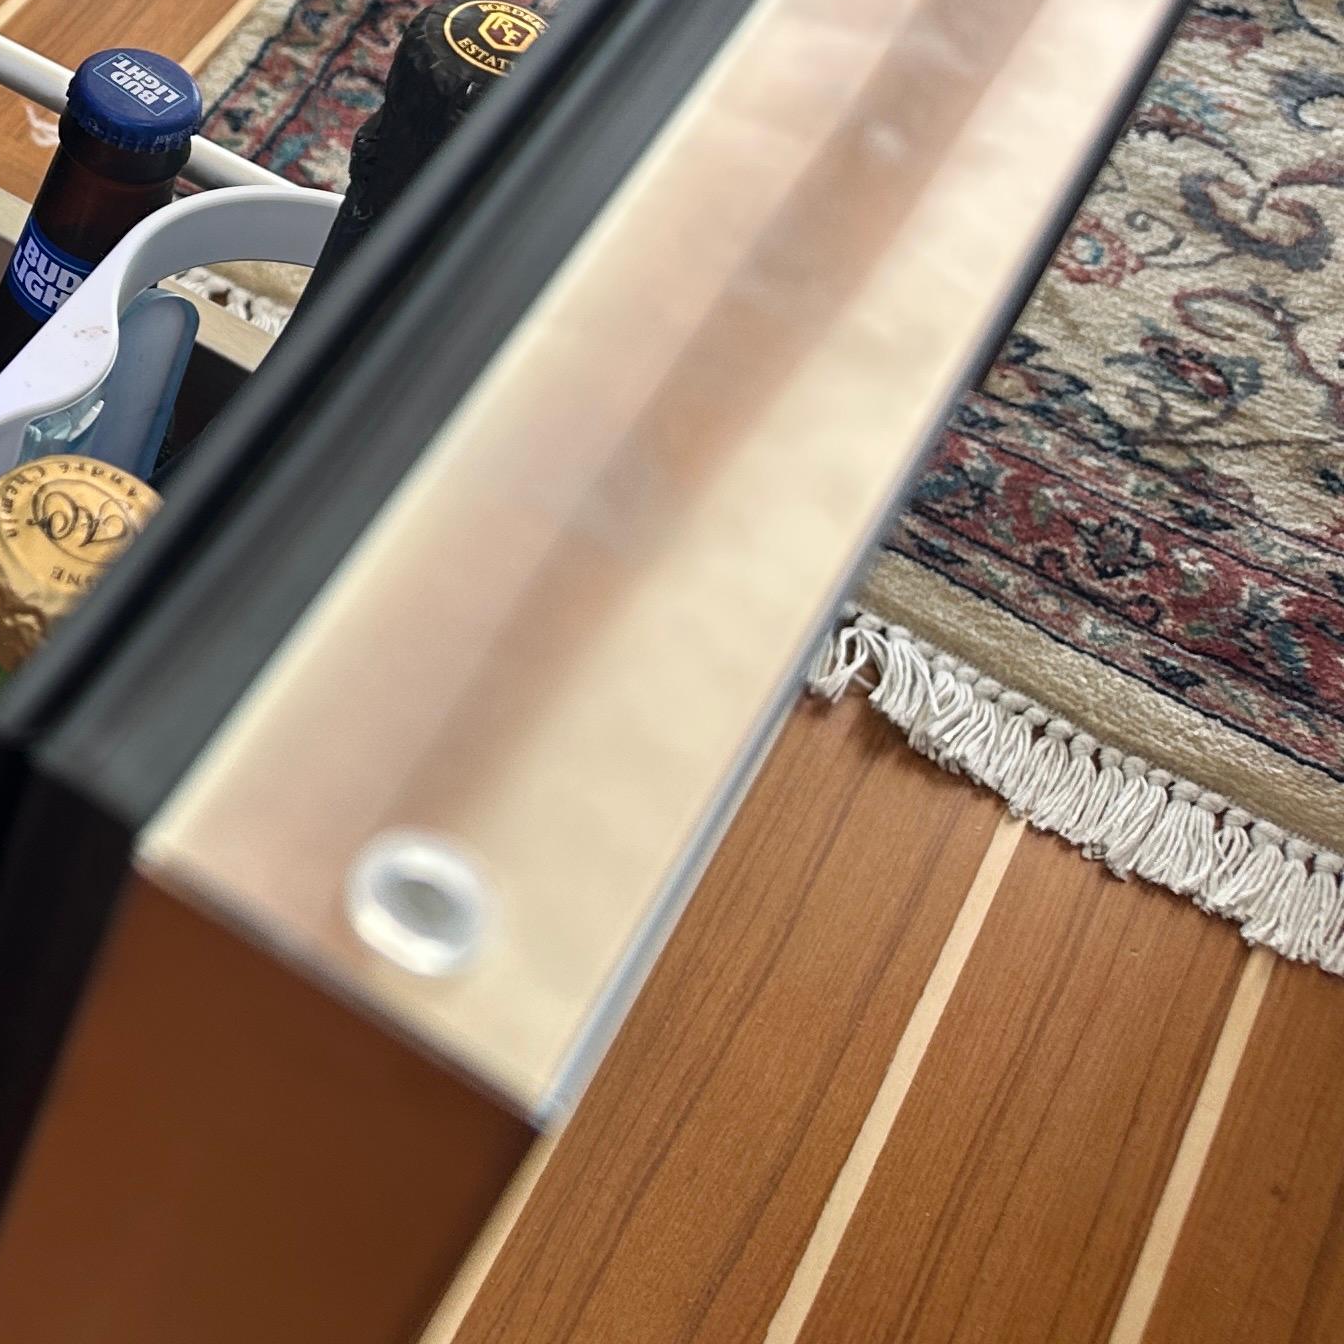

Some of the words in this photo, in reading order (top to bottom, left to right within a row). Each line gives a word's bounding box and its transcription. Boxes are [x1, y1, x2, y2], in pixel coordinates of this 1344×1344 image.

[457, 36, 511, 70] ESTAT
[110, 70, 160, 106] BUD
[111, 58, 180, 105] LIGHT
[13, 244, 71, 312] LIGH
[23, 235, 83, 294] BUD
